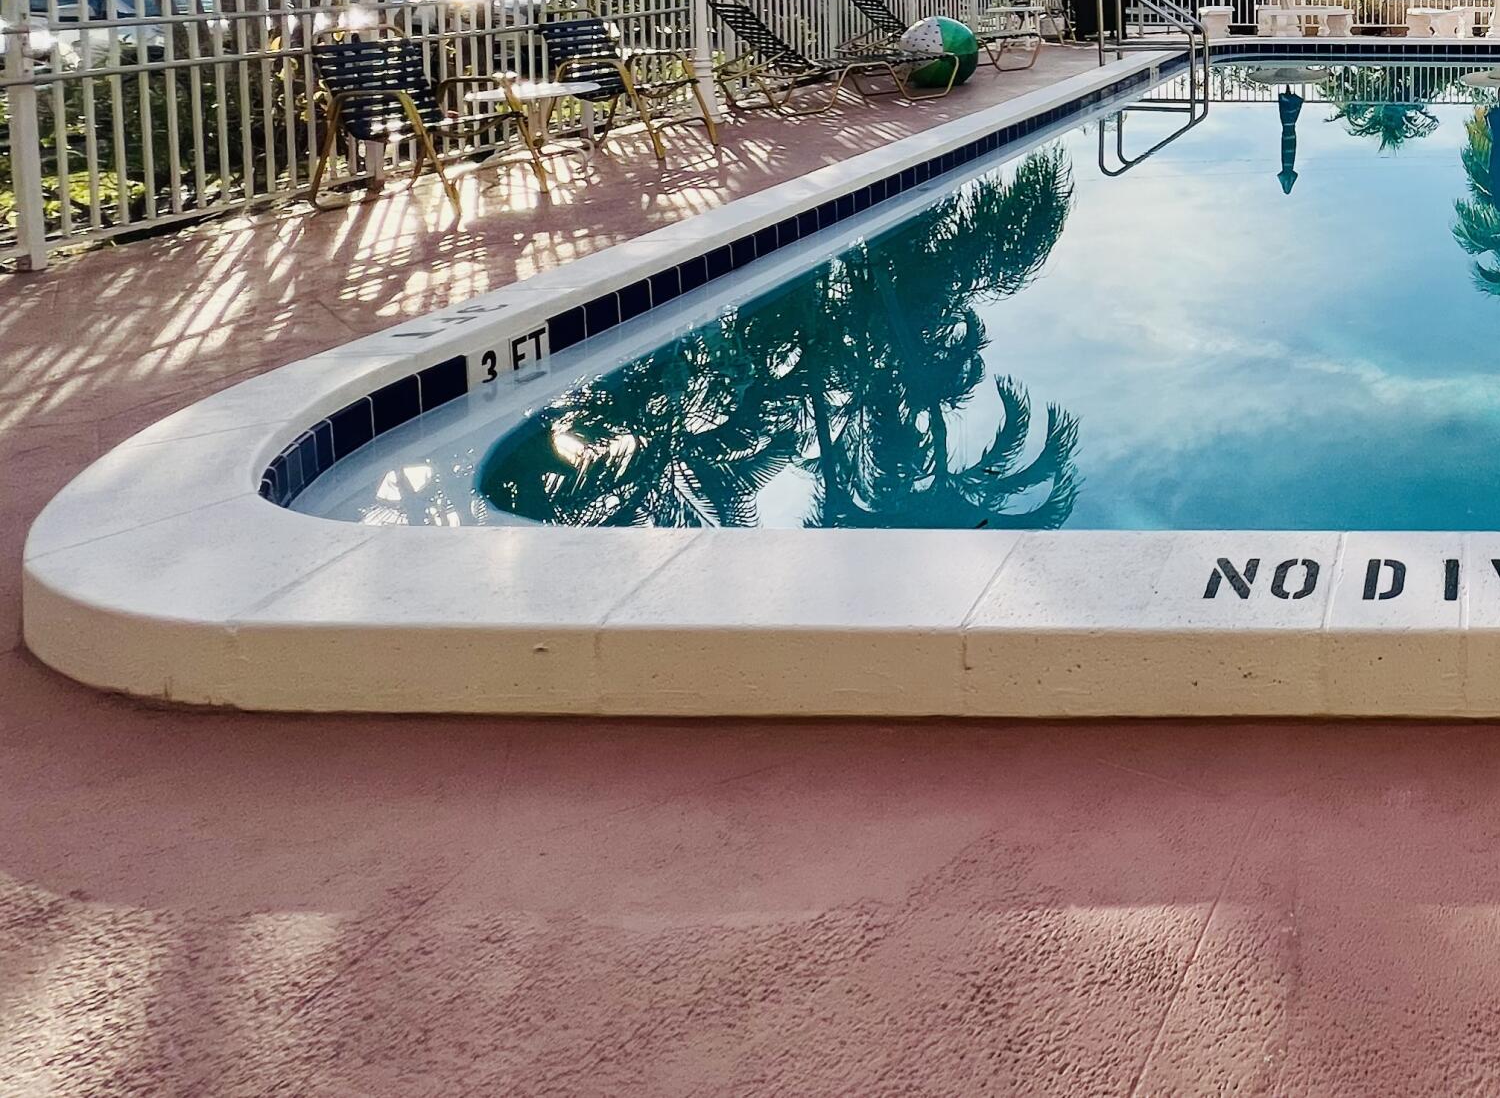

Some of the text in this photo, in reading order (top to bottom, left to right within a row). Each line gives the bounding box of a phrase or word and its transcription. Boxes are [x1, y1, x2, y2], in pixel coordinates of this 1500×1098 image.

[481, 326, 546, 383] 3 FT
[1202, 557, 1321, 601] NO
